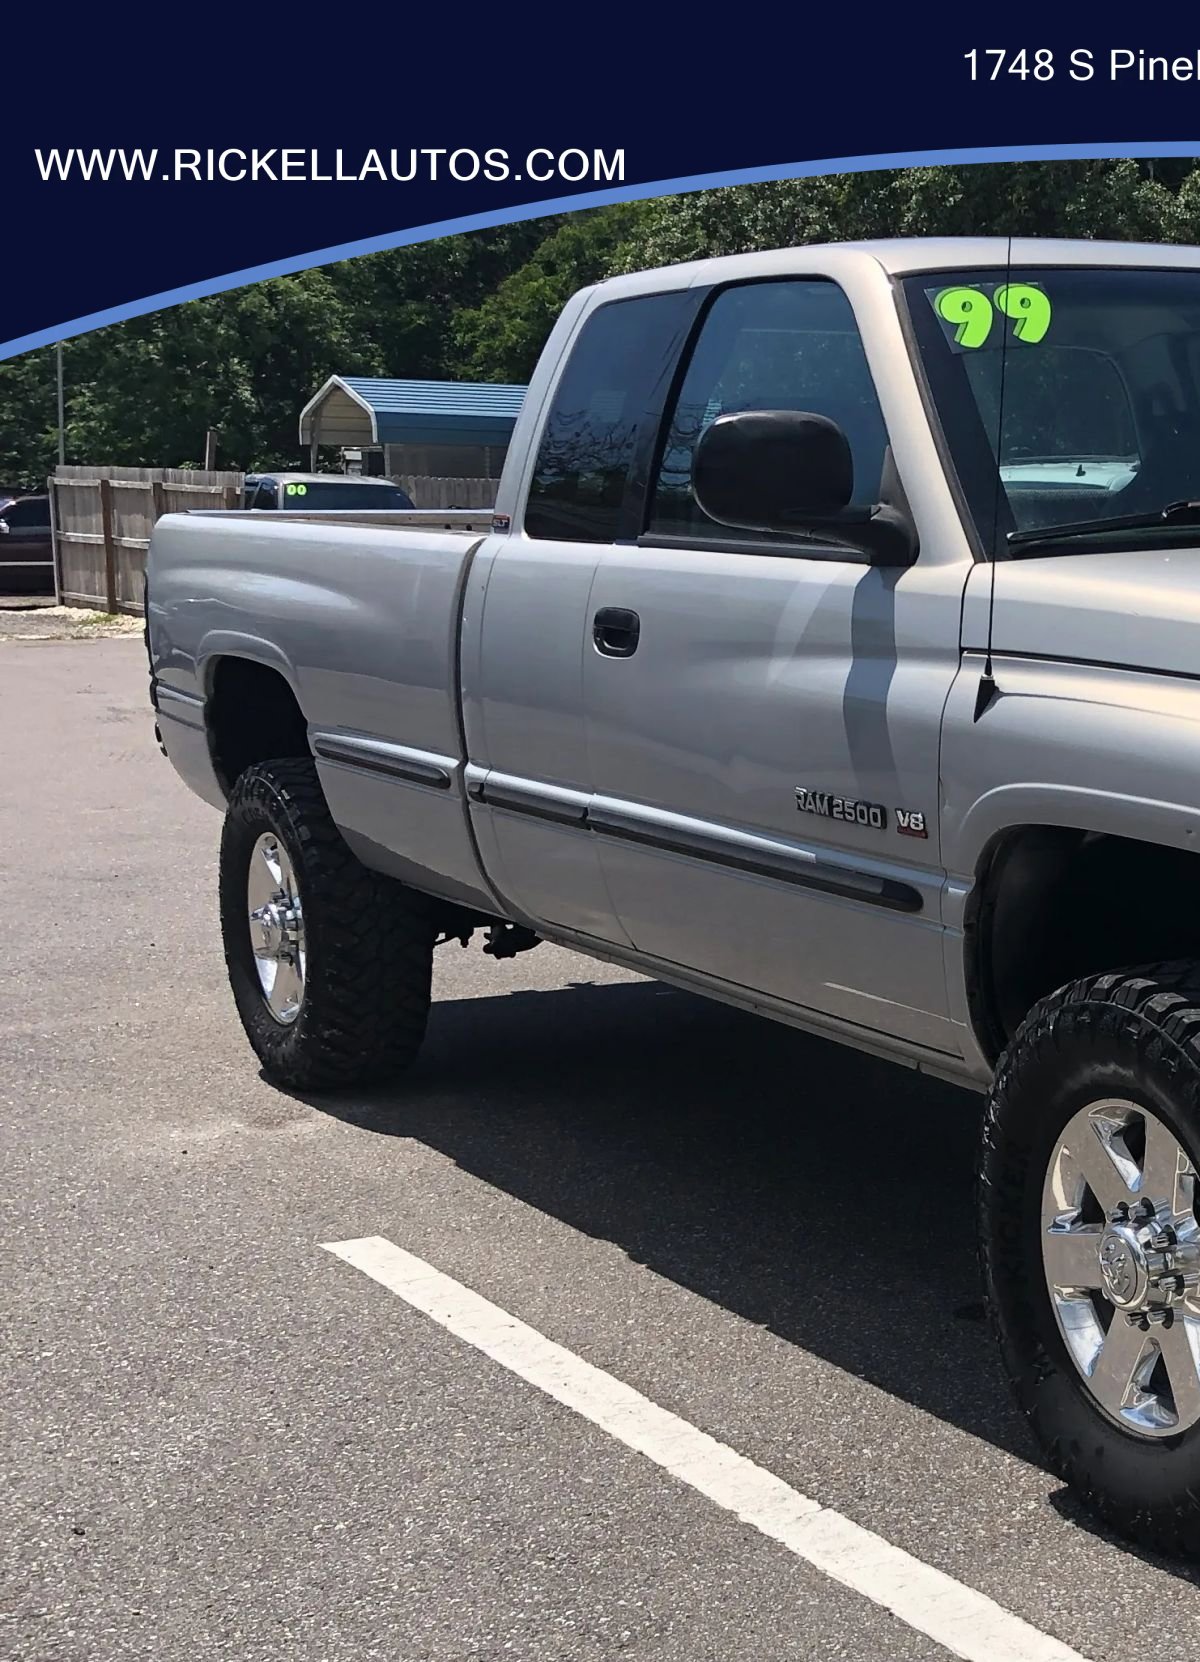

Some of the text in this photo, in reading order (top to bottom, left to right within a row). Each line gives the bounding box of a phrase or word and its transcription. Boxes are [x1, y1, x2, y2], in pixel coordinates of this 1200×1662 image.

[934, 284, 1052, 349] 99
[286, 484, 307, 496] 00
[795, 786, 885, 829] RAM 2500
[896, 809, 926, 831] V8
